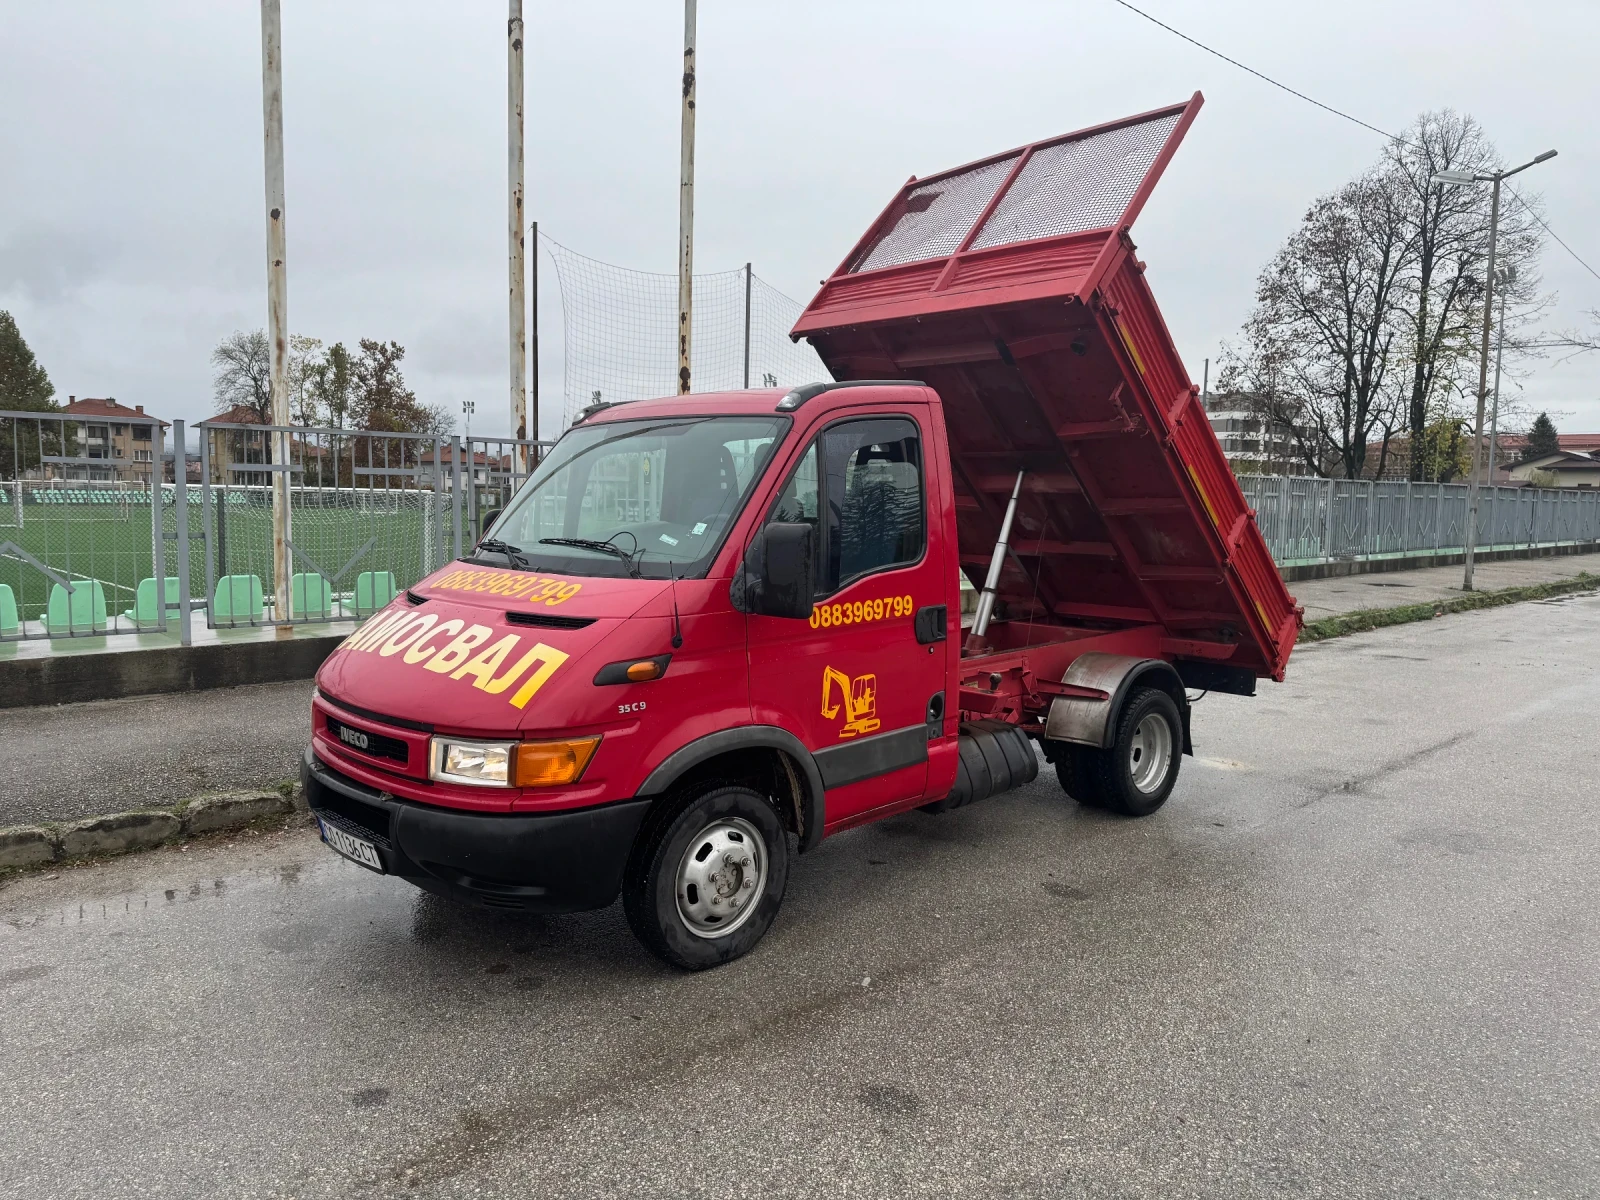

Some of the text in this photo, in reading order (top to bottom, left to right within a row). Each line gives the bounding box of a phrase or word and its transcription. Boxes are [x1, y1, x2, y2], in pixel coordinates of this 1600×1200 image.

[430, 570, 582, 606] 0883969799
[809, 594, 913, 629] 0883969799
[337, 609, 570, 710] АМОСВАЛ
[340, 725, 369, 749] IVECO
